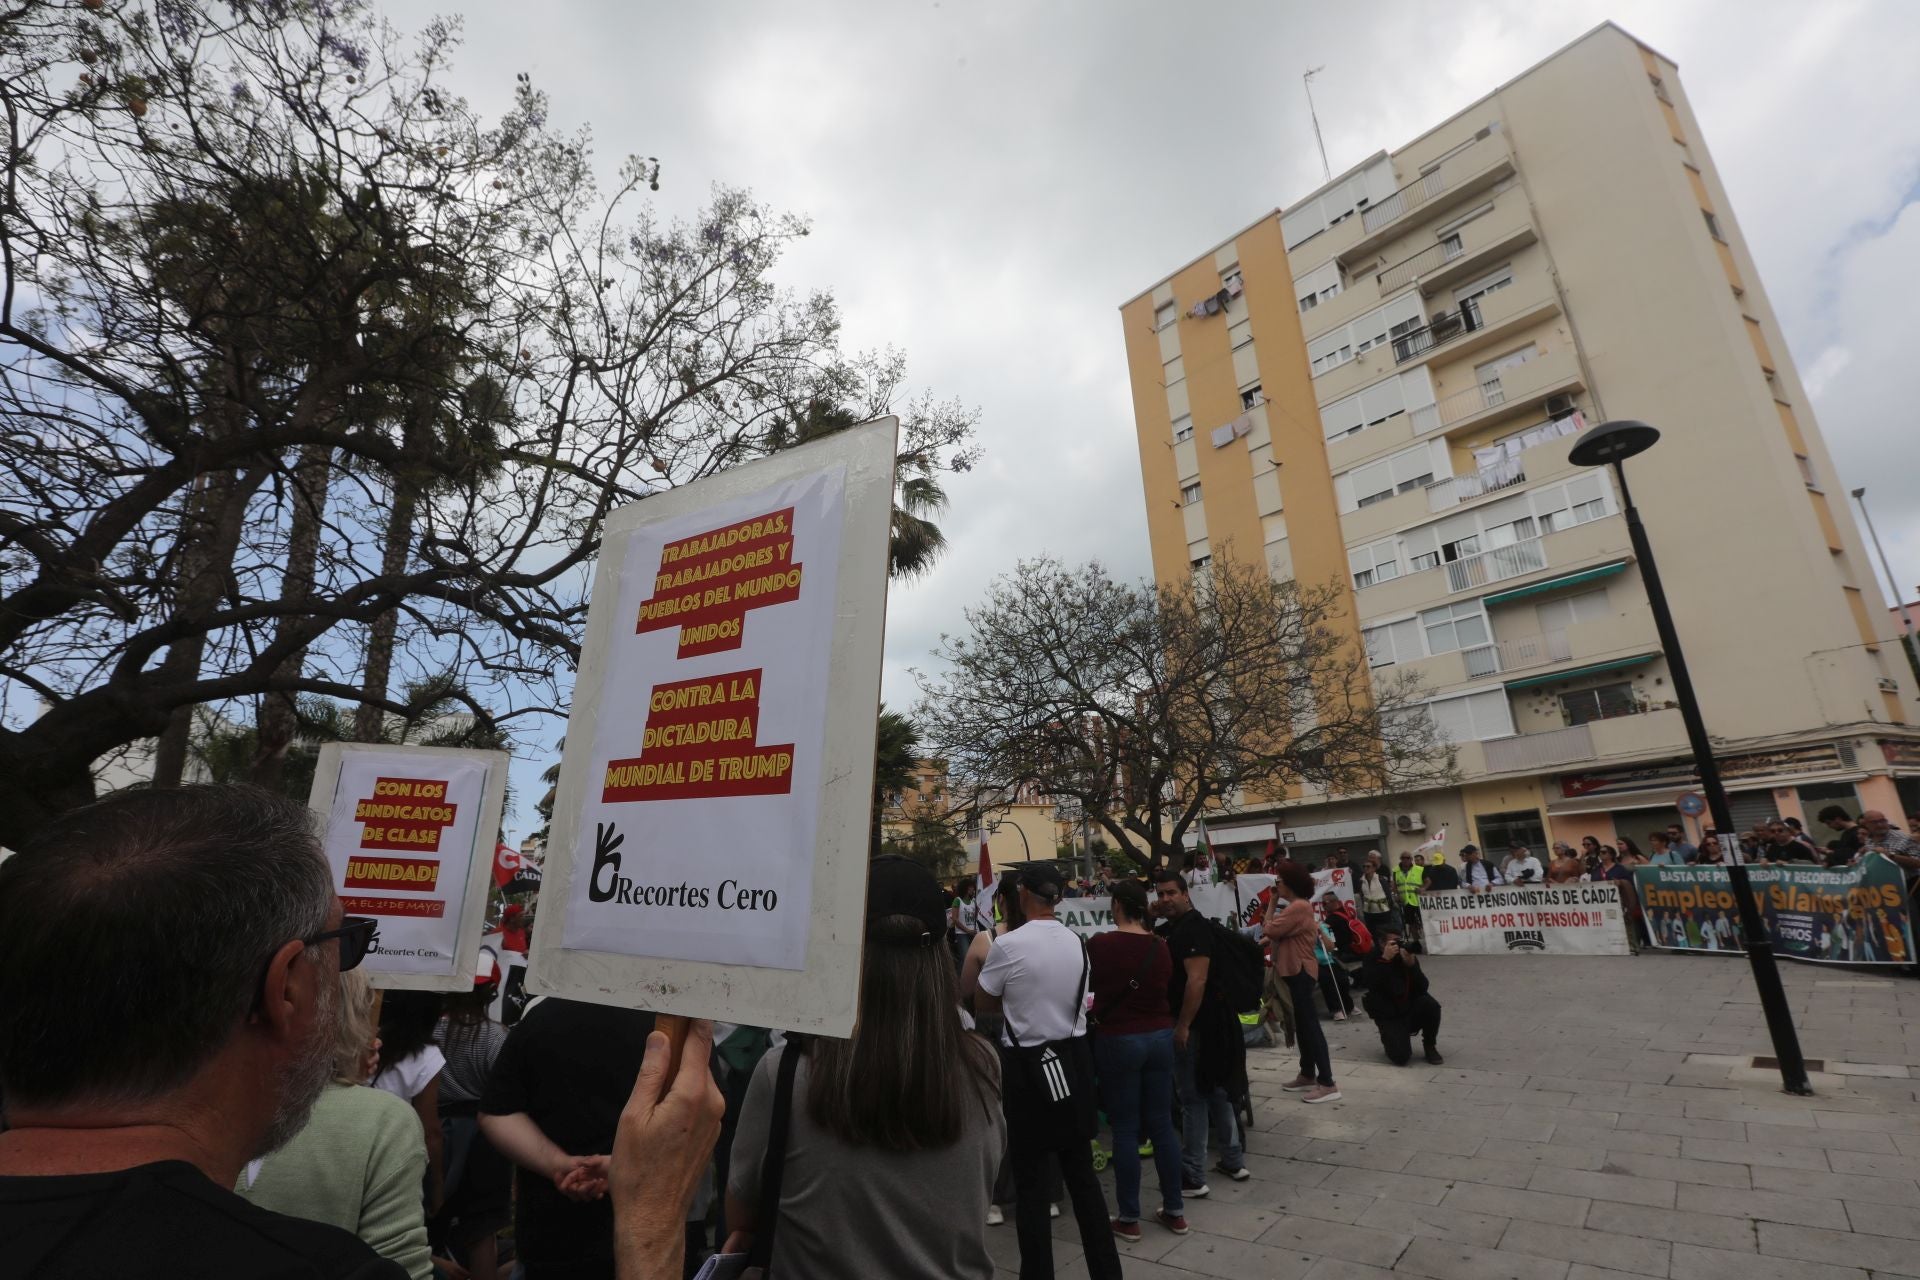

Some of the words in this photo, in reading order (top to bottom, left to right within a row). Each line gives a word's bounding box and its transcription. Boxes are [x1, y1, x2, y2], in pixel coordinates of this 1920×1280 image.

[663, 515, 788, 564] TRABAJADORAS,
[656, 547, 773, 591] TRABAJADORES
[777, 541, 790, 560] Y
[638, 593, 701, 622] PUEBLOS
[703, 585, 731, 607] DEL
[735, 569, 801, 600] MUNDO
[679, 618, 740, 647] UNIDOS
[650, 682, 725, 712] CONTRA
[730, 677, 756, 701] LA
[643, 717, 752, 748] DICTADURA
[604, 762, 684, 788] MUNDIAL
[689, 759, 714, 782] DE
[719, 753, 791, 780] TRUMP
[375, 782, 411, 797] CON
[414, 784, 443, 798] LOS
[356, 803, 452, 821] SINDICATOS
[363, 827, 384, 841] DE
[387, 829, 438, 844] CLASE
[347, 861, 439, 882] ¡UNIDAD!
[514, 870, 542, 881] CÁDI
[1660, 871, 1696, 882] BASTA
[1697, 871, 1711, 882] DE
[1783, 870, 1793, 882] Y
[360, 900, 374, 908] EL
[390, 901, 402, 909] DE
[616, 877, 709, 908] Recortes
[717, 879, 778, 911] Cero
[1420, 895, 1458, 911] MAREA
[1461, 894, 1475, 910] DE
[1478, 890, 1559, 909] PENSIONISTAS
[1563, 889, 1579, 905] DE
[1582, 886, 1618, 904] CÁDIZ
[1644, 883, 1737, 913] Empleo
[1452, 915, 1488, 930] LUCHA
[1491, 914, 1515, 928] POR
[1518, 913, 1534, 927] TU
[1538, 908, 1589, 927] PENSIÓN
[1504, 930, 1545, 944] MAREA
[377, 946, 415, 957] Recortes
[418, 948, 438, 958] Cero
